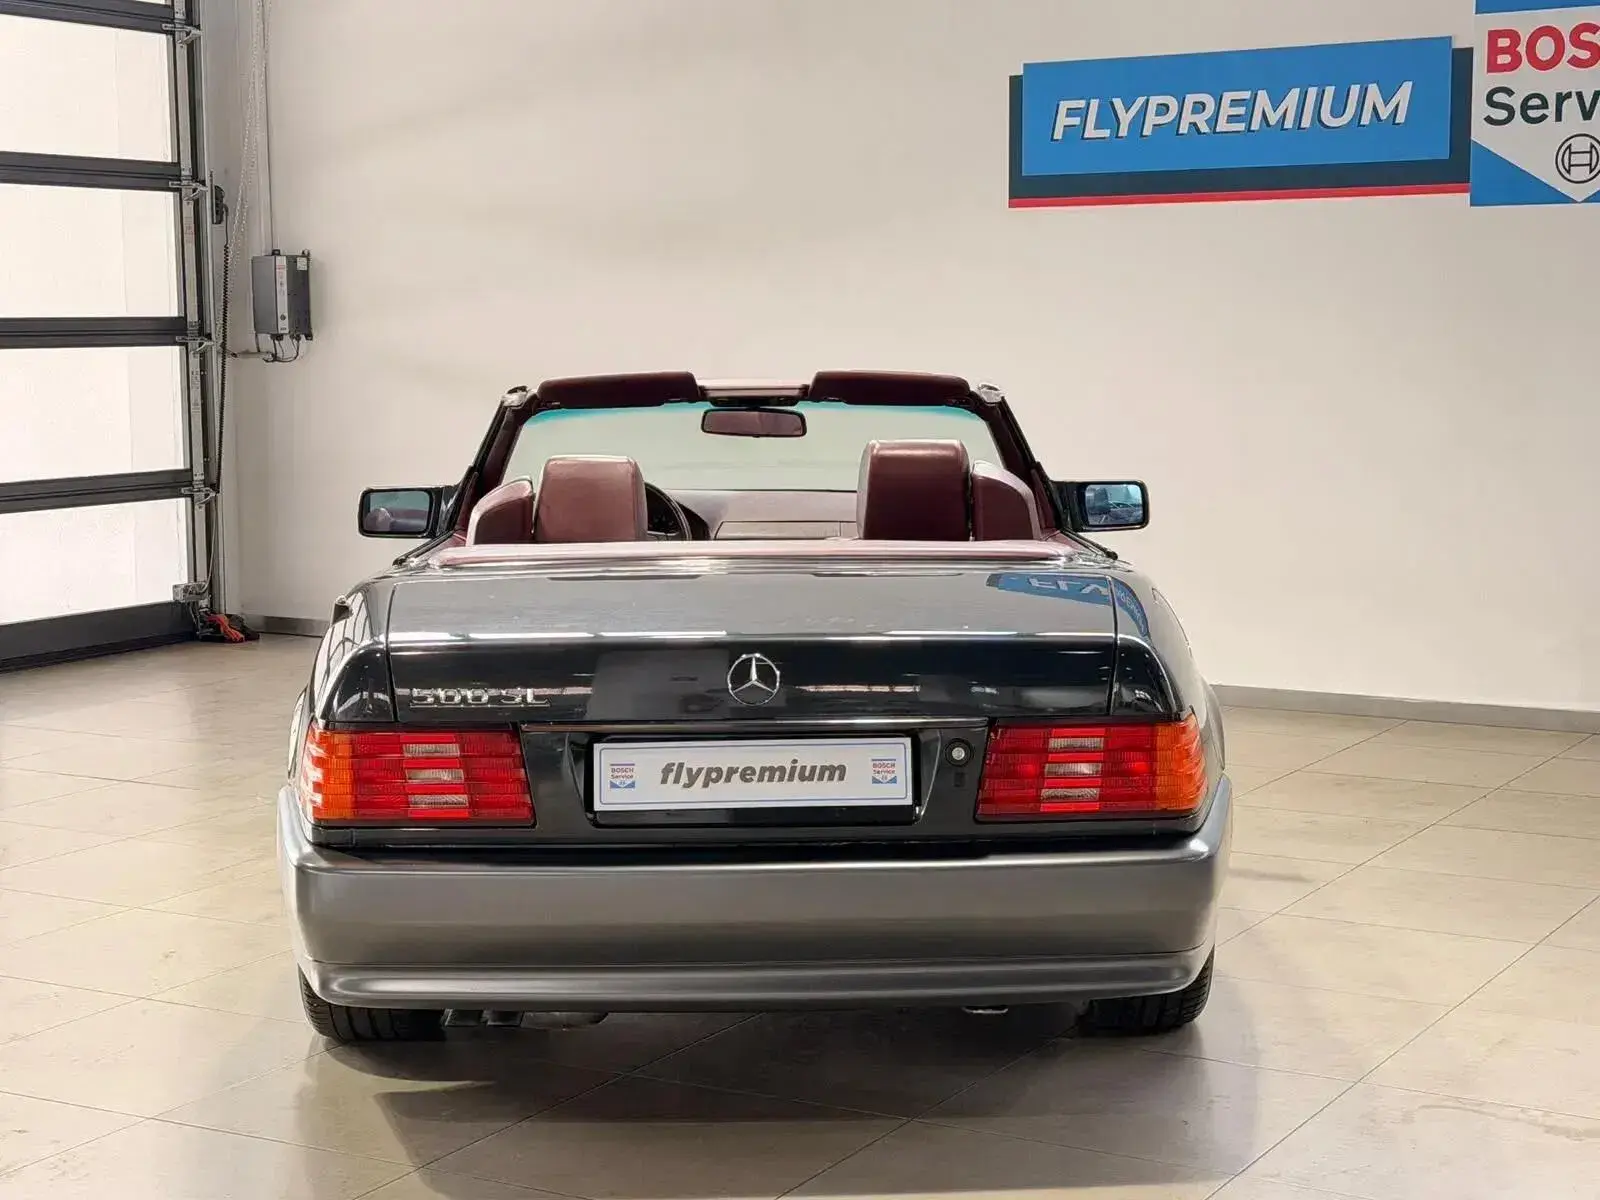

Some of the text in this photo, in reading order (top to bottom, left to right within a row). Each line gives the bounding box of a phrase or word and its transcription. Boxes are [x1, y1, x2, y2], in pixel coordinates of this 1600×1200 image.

[1050, 80, 1414, 142] FLYPREMIUM
[410, 686, 550, 705] 500 SL
[660, 759, 846, 788] flypremium
